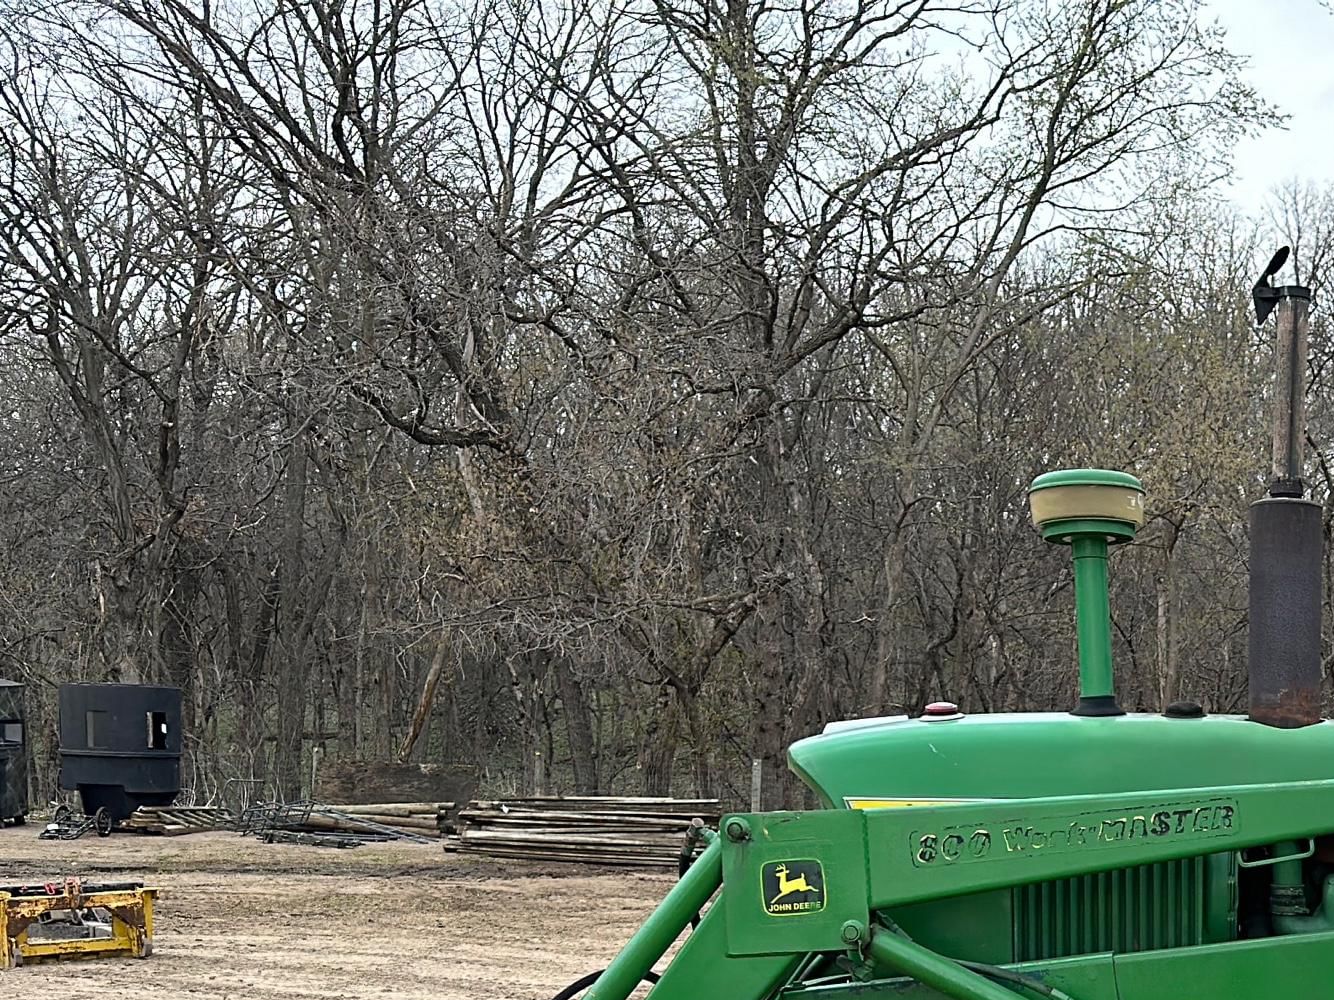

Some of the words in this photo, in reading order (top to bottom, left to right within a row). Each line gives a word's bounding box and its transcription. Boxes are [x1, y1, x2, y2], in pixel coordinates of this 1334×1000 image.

[916, 829, 992, 864] 800
[768, 903, 792, 912] JOHN
[793, 901, 822, 911] DEERE
